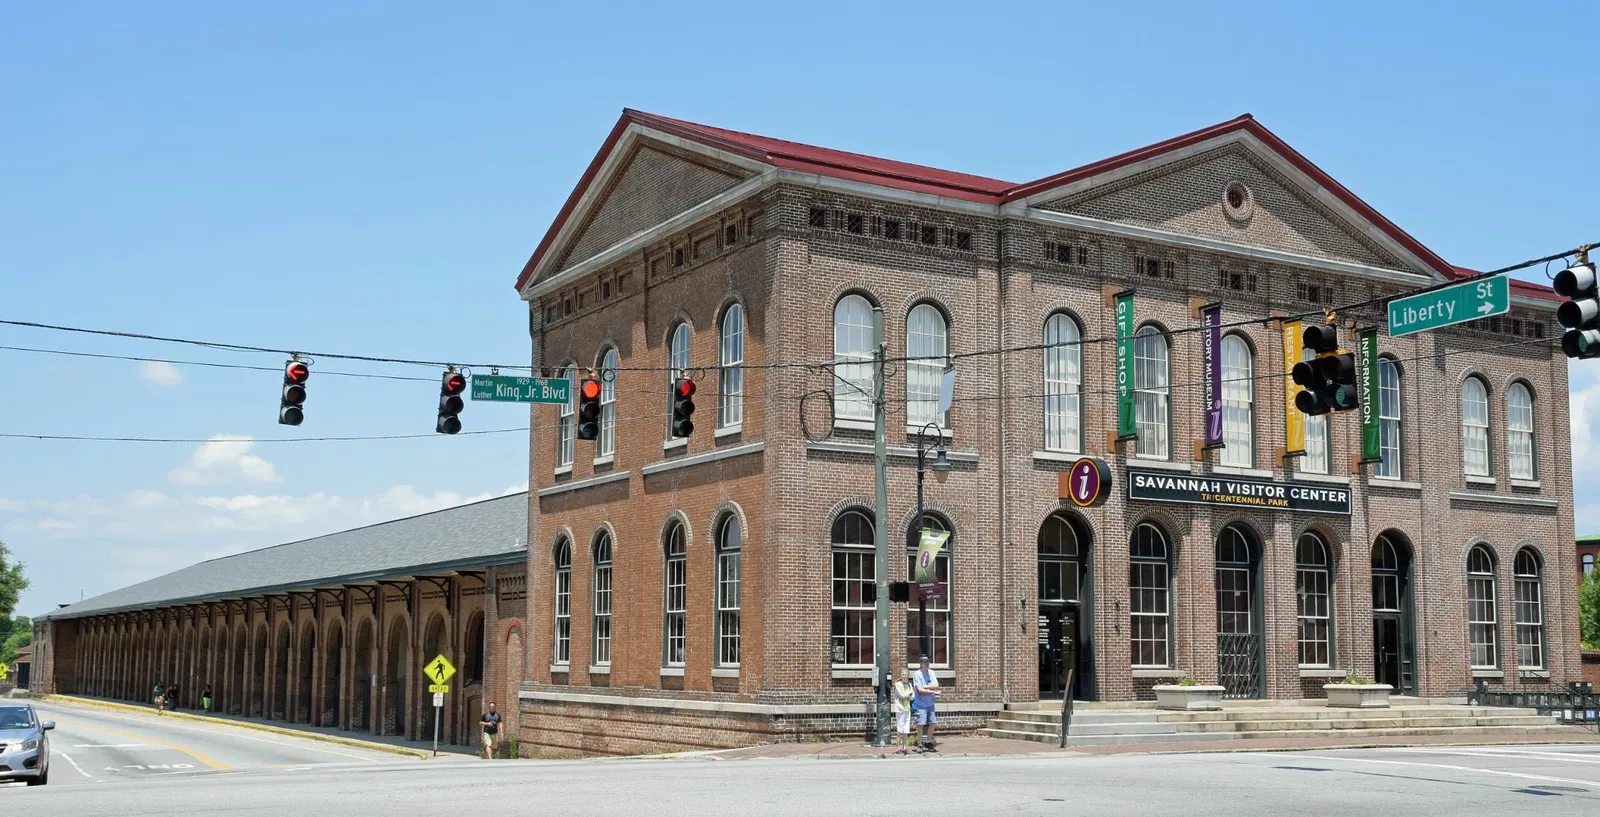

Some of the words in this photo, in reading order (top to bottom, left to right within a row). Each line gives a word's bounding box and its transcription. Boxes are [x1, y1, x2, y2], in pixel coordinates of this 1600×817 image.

[1476, 281, 1493, 299] St
[1392, 299, 1456, 328] Liberty
[1118, 346, 1127, 397] SHOP
[474, 379, 493, 387] Martin
[516, 377, 530, 385] 1929
[1205, 363, 1213, 411] MUSEUM
[1361, 337, 1371, 425] INFORMATION
[473, 391, 493, 399] Luther
[525, 385, 539, 399] Jr.
[542, 386, 567, 400] Blvd.
[1135, 475, 1221, 493] SAVANNAH
[1226, 482, 1285, 498] VISITOR
[1290, 488, 1347, 503] CENTER
[1201, 493, 1266, 505] TRICENTENNIAL
[1268, 498, 1289, 507] PARK
